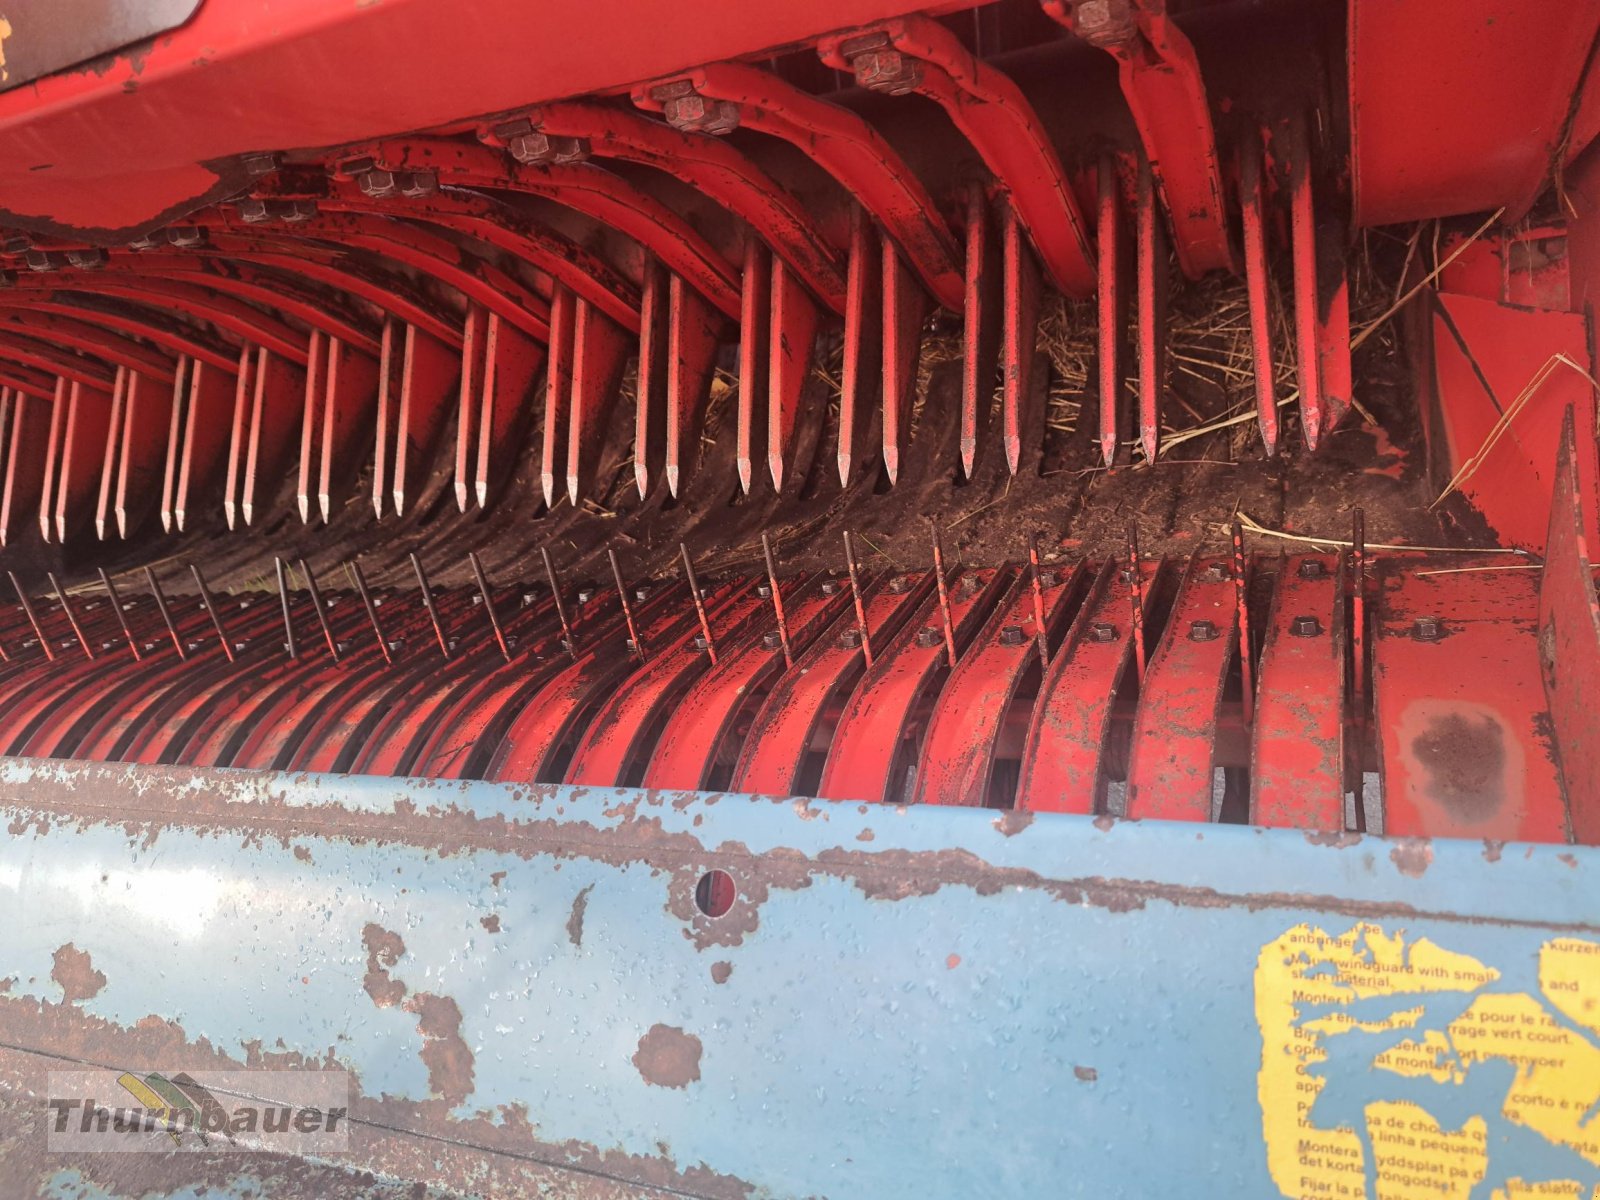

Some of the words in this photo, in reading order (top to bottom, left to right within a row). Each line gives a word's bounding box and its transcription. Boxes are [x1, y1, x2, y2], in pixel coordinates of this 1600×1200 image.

[1419, 966, 1449, 979] with
[1454, 970, 1495, 983] small
[1549, 981, 1580, 993] and
[1292, 989, 1341, 1003] Monter
[1480, 1011, 1516, 1024] pour
[1521, 1013, 1535, 1025] le
[1492, 1027, 1522, 1040] vert
[1511, 1094, 1556, 1108] corto
[1386, 1117, 1406, 1129] de
[1379, 1130, 1416, 1147] linha
[1298, 1139, 1359, 1158] Montera
[1299, 1154, 1323, 1168] det
[1300, 1175, 1333, 1192] Fijar
[1336, 1181, 1350, 1195] la
